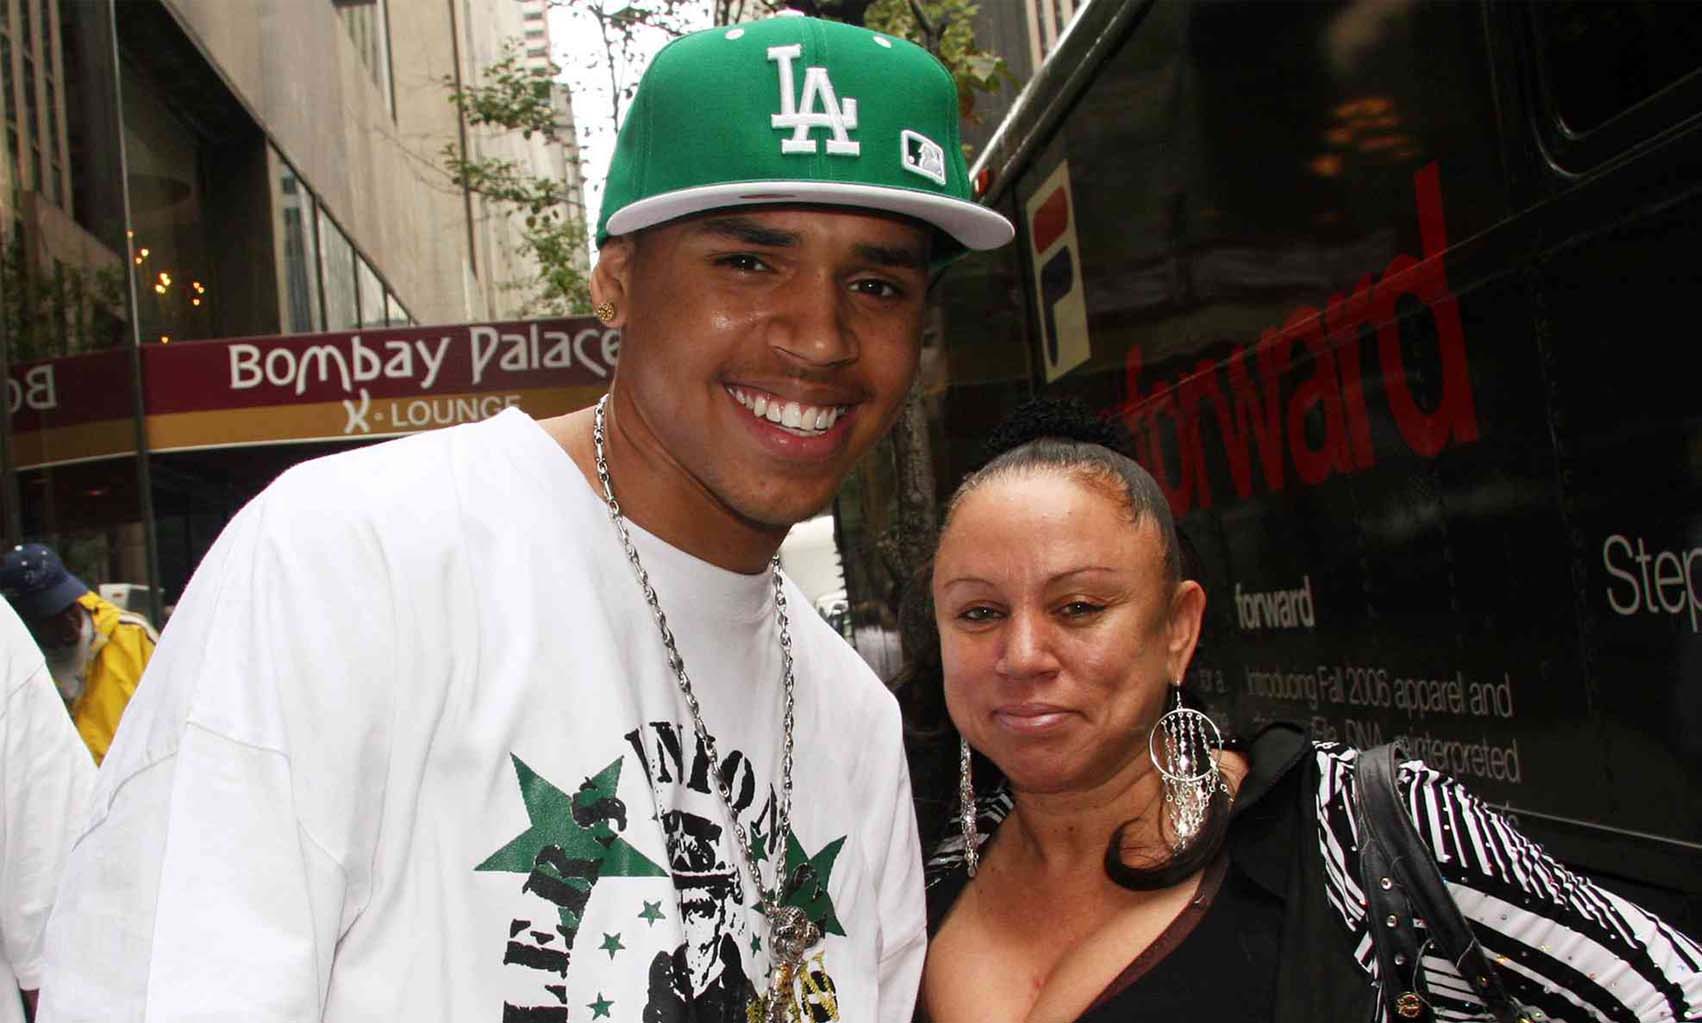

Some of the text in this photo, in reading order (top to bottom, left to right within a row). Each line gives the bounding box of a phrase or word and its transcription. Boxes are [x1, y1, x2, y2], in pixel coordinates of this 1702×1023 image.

[767, 44, 860, 156] LA
[228, 324, 620, 395] Bombay Palace
[1103, 160, 1481, 518] forward
[1233, 574, 1316, 631] forward
[1603, 534, 1702, 633] Step
[1244, 663, 1516, 721] Introducing Fall 2006 apparel and
